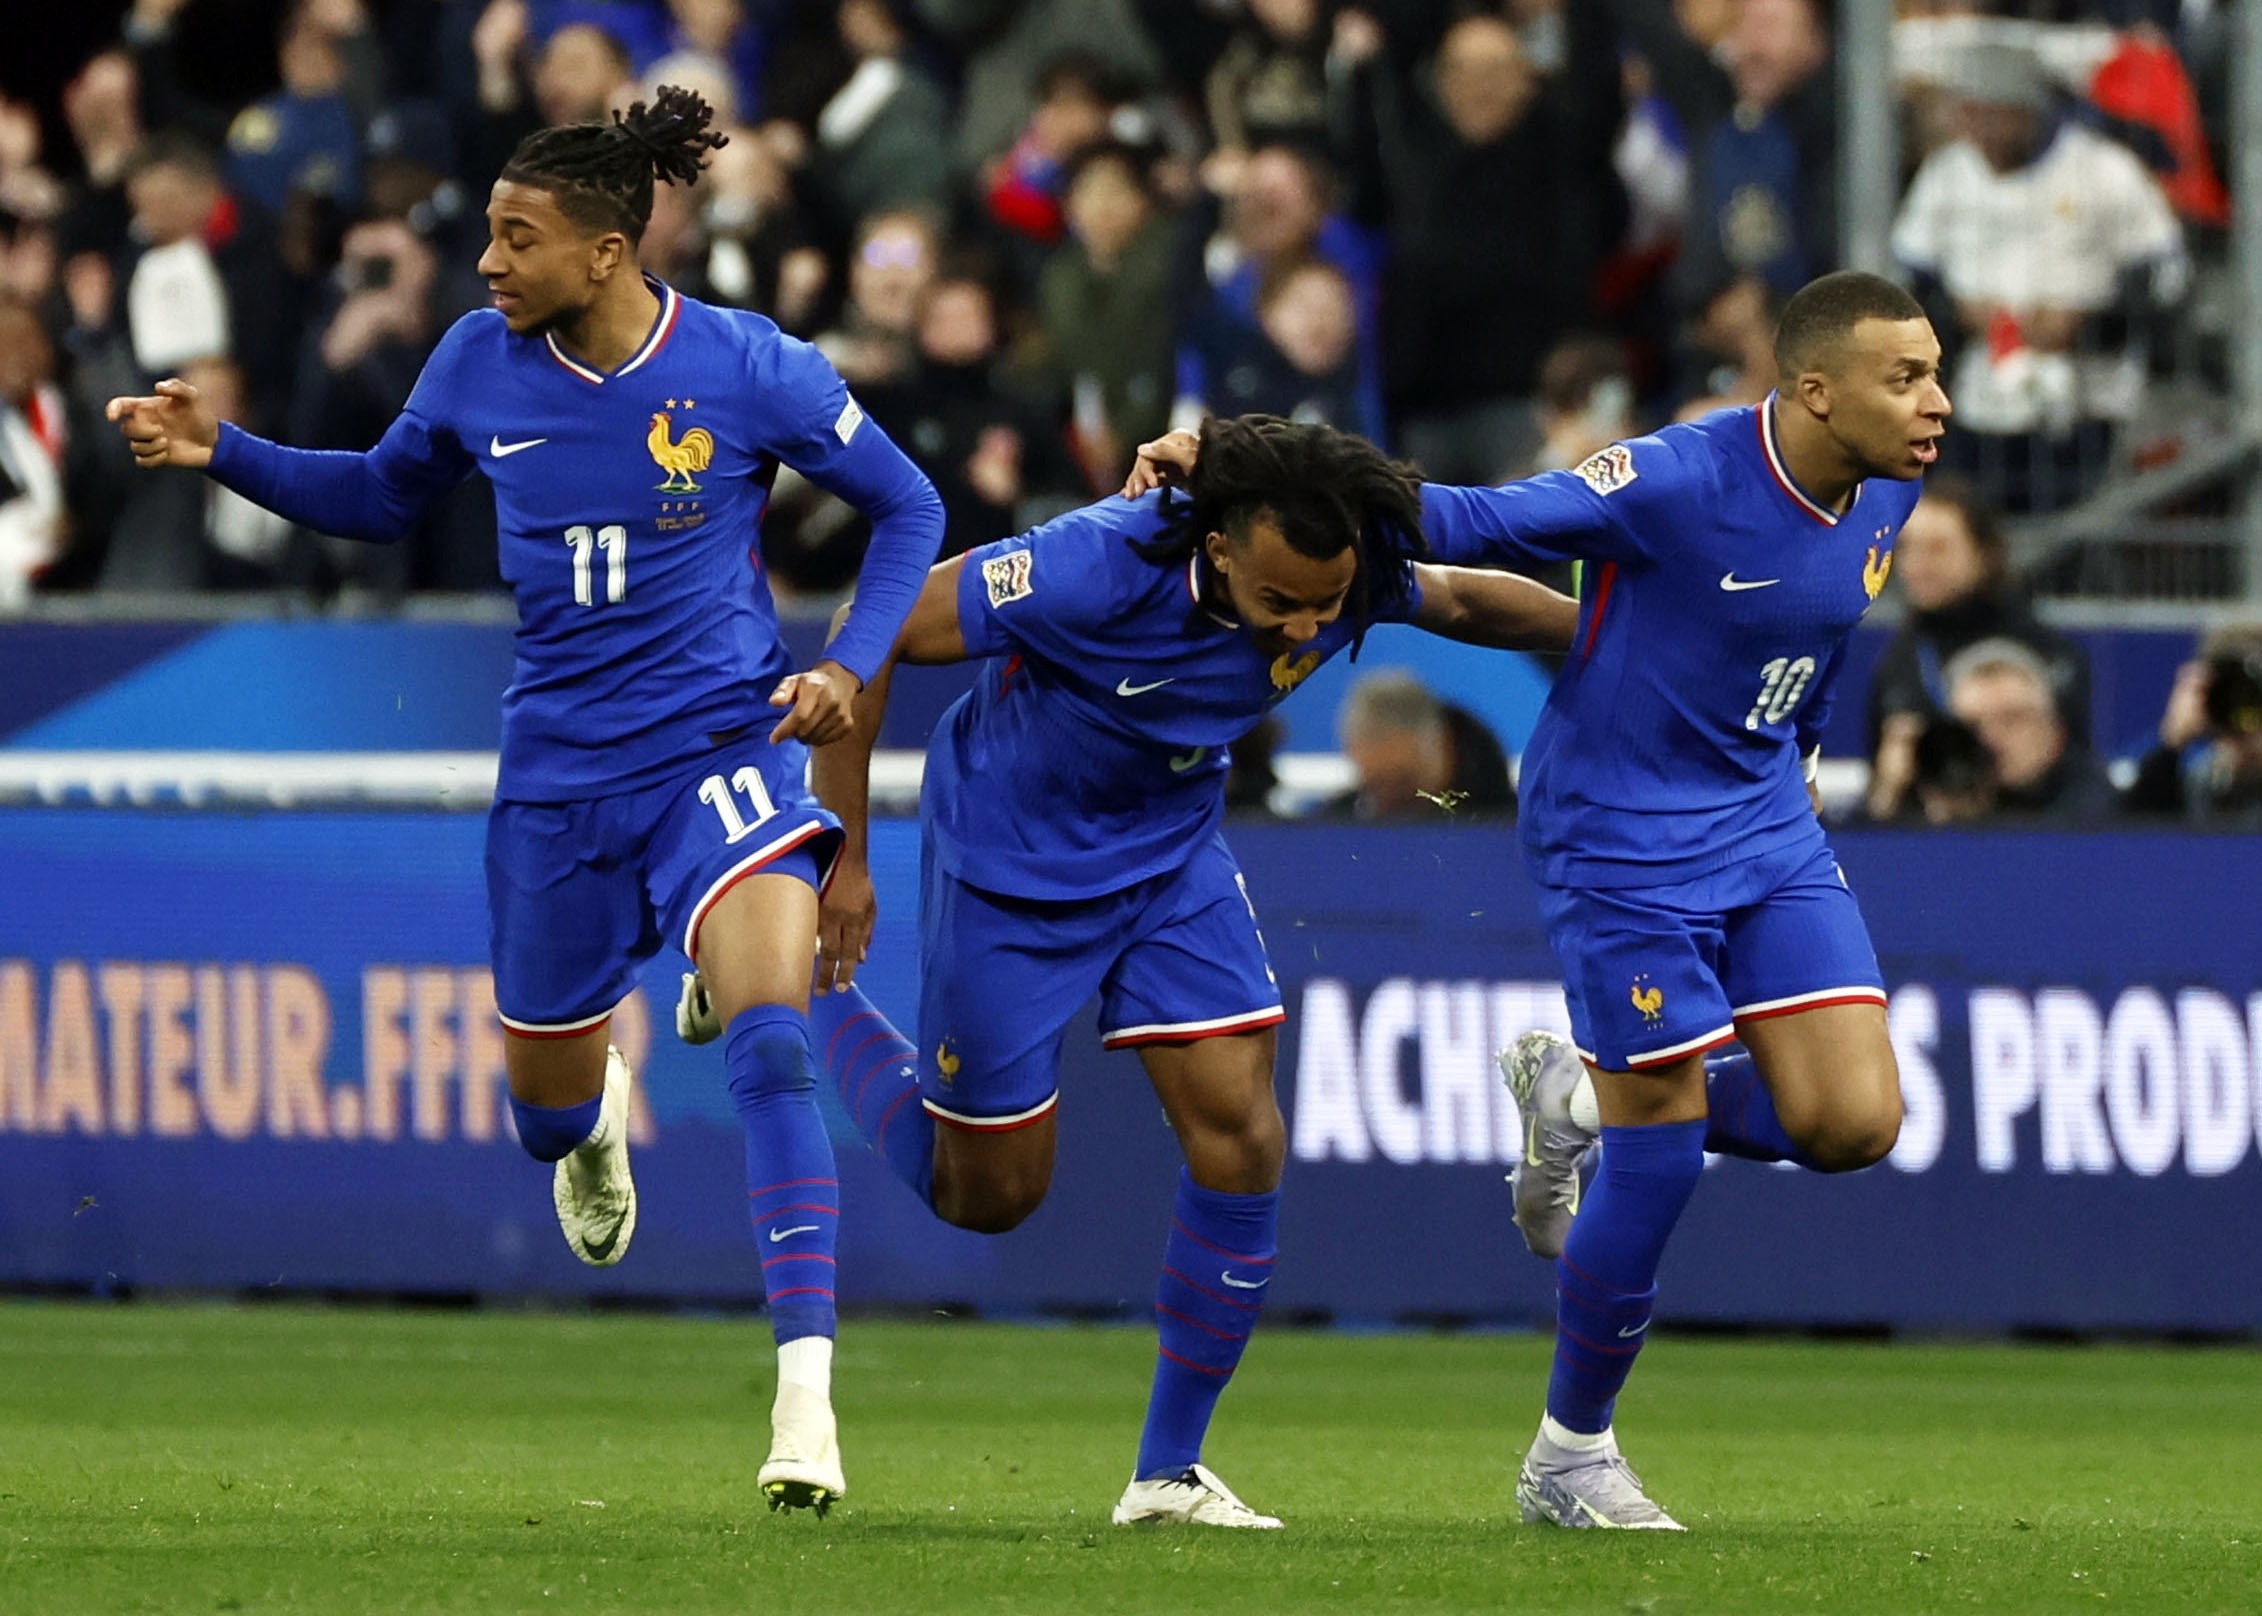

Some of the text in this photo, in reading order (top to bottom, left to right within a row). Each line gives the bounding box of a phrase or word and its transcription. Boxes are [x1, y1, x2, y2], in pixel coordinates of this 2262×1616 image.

[563, 525, 627, 607] 11
[1745, 656, 1816, 730] 10
[697, 766, 780, 844] 11
[1968, 985, 2262, 1178] PROD
